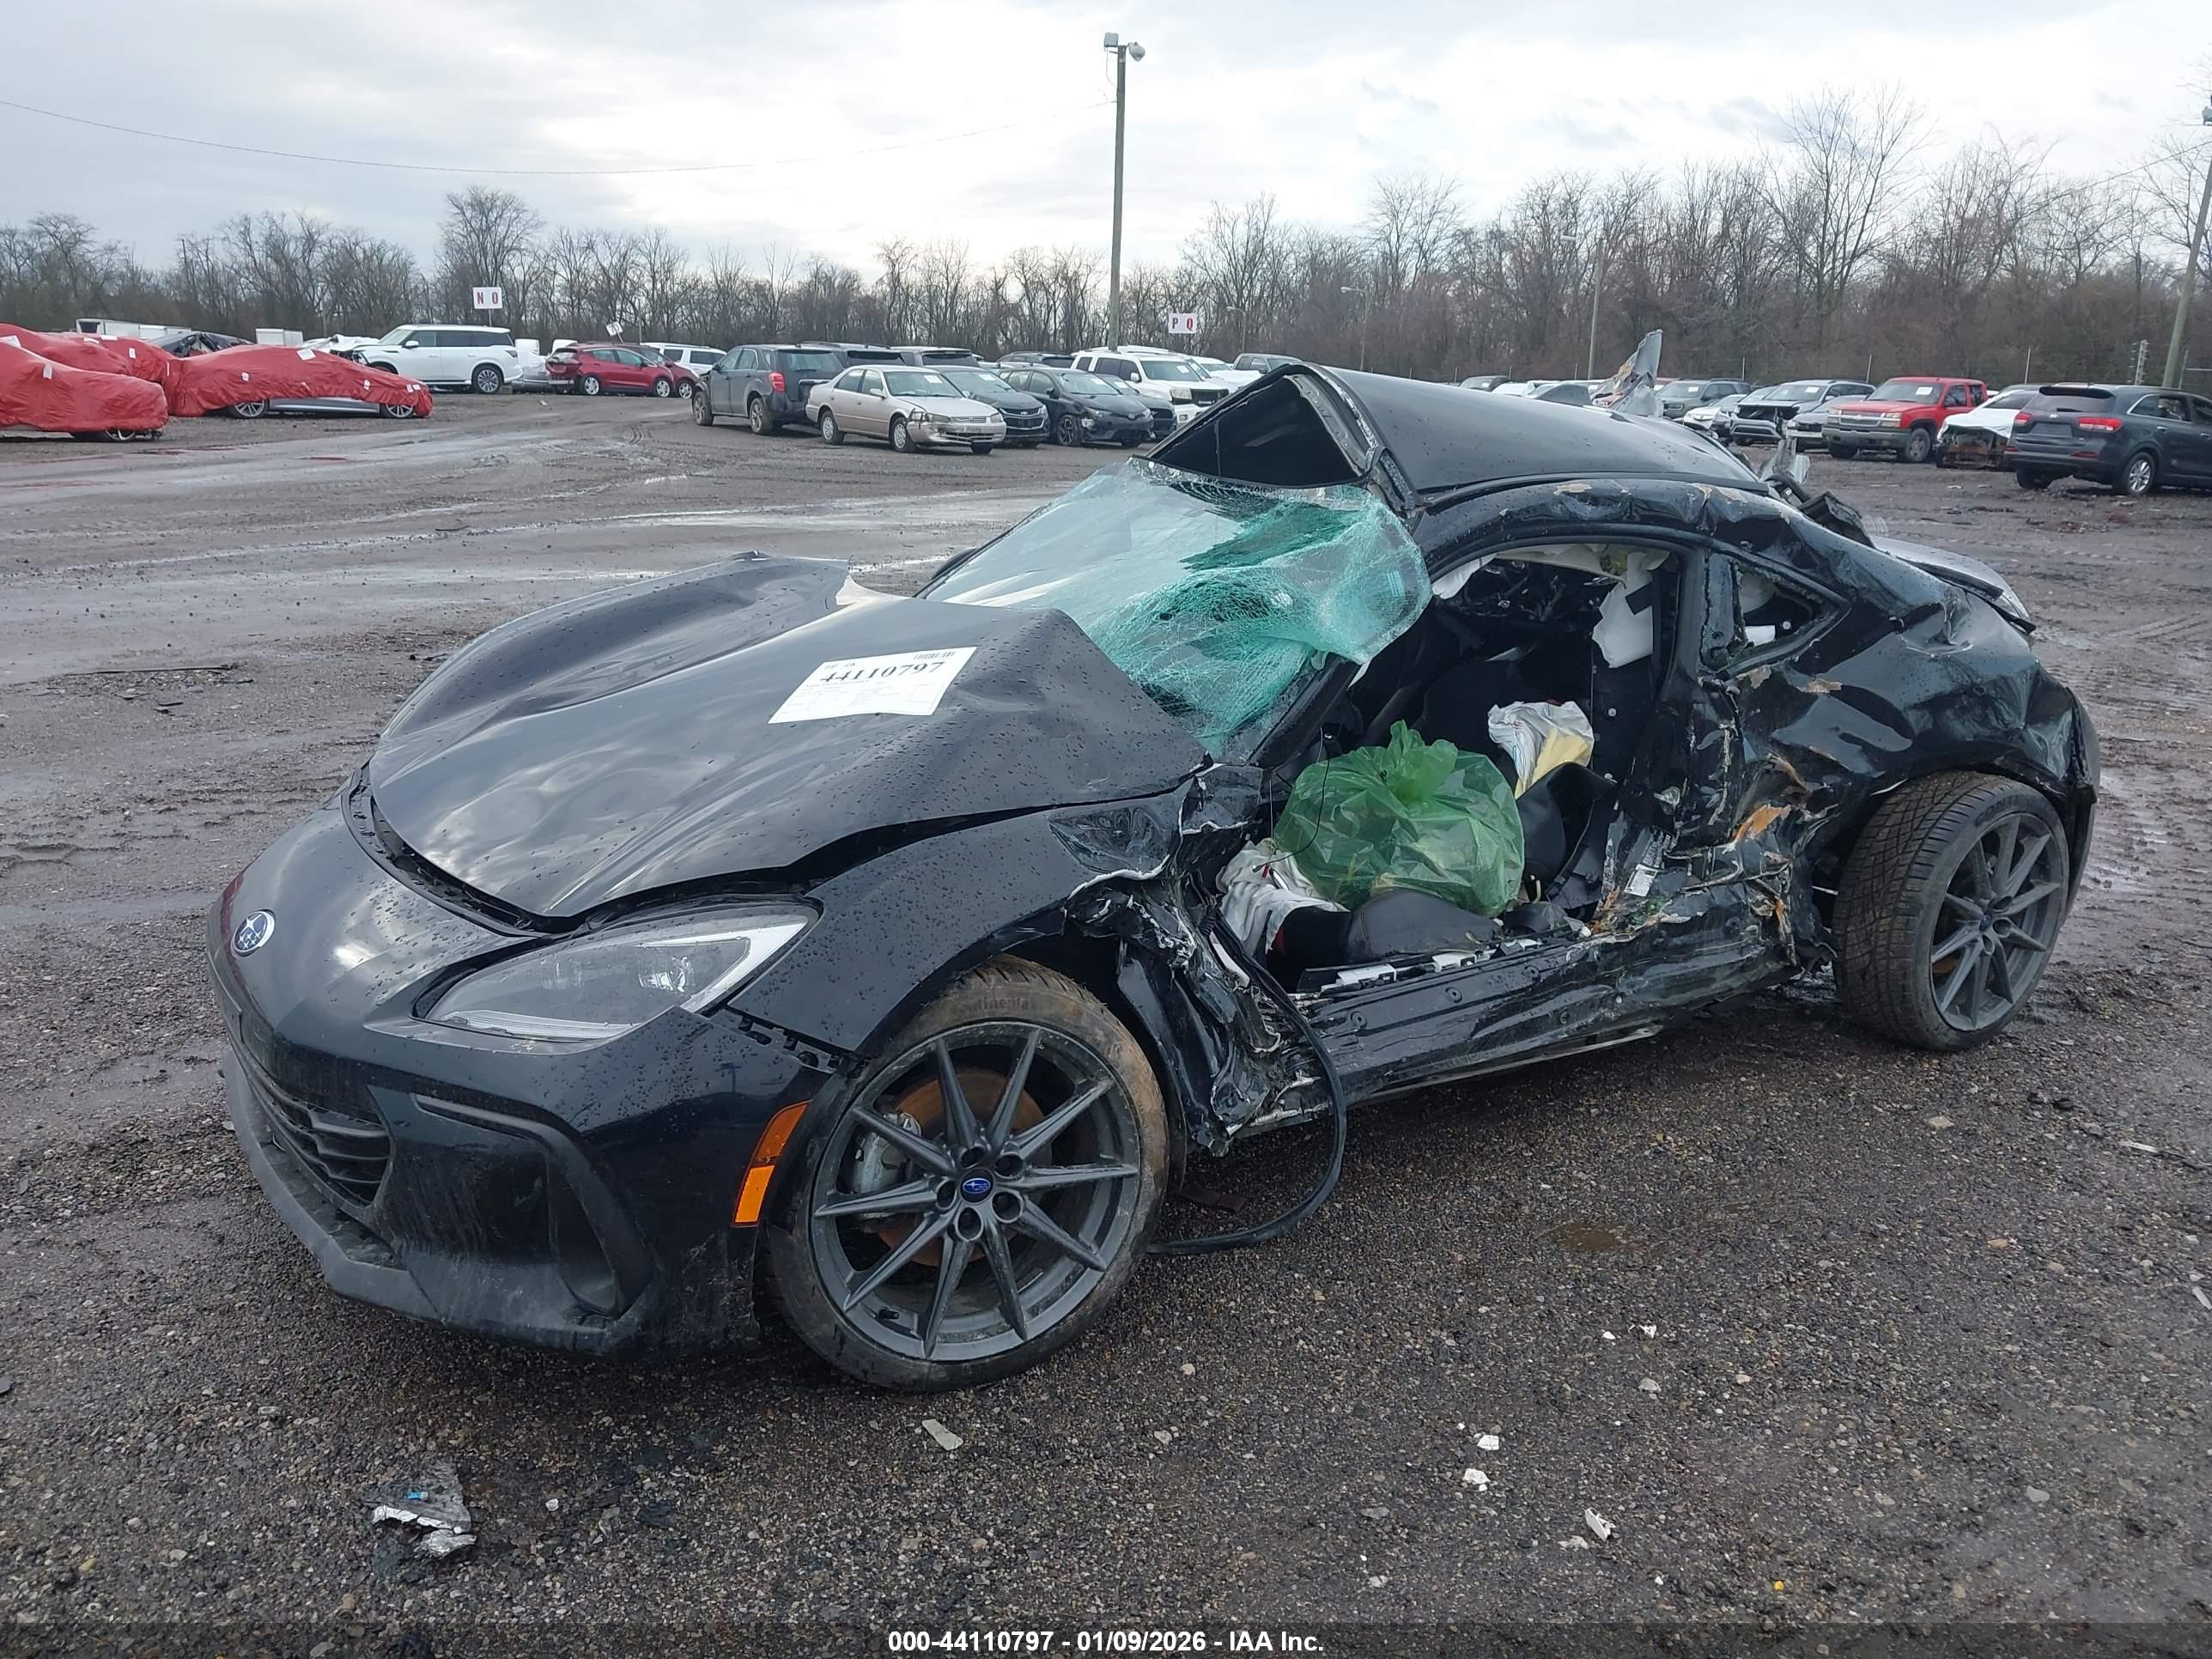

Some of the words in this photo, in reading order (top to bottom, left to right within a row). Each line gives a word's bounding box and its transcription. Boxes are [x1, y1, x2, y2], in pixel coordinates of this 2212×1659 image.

[477, 291, 484, 305] N
[1172, 317, 1179, 329] P
[1186, 317, 1194, 331] Q
[819, 661, 945, 683] 44110797
